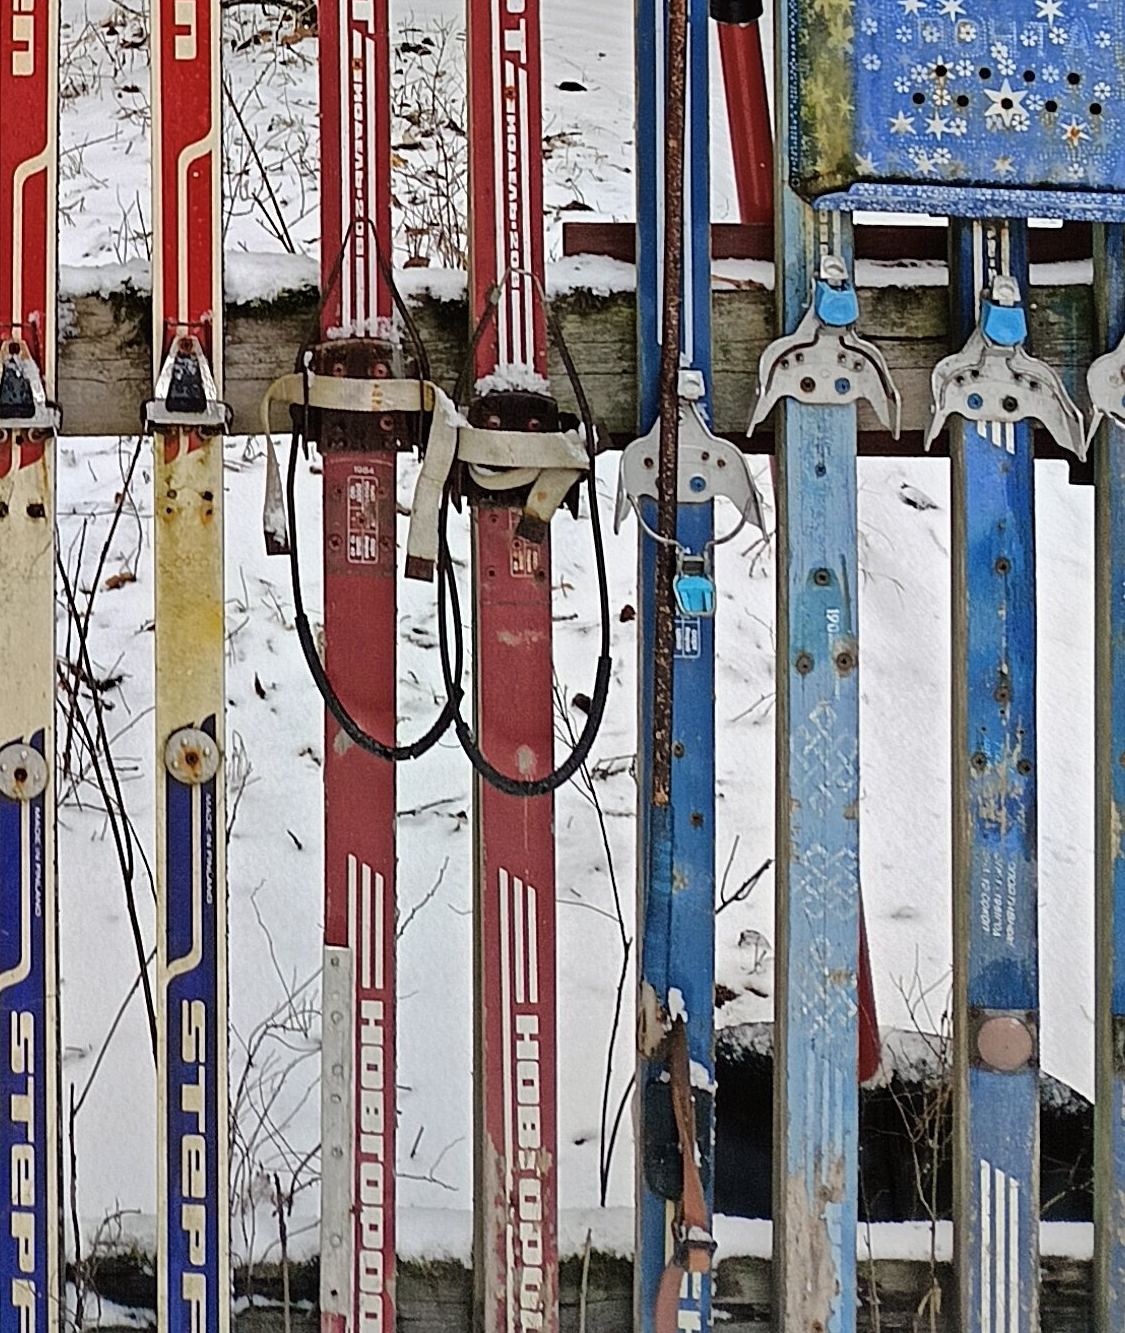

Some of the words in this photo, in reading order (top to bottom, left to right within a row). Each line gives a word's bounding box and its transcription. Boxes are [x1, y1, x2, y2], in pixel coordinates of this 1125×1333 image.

[826, 608, 840, 633] 190
[34, 806, 42, 844] MADE
[205, 793, 213, 831] MADE
[34, 863, 42, 918] FINLAND
[205, 849, 213, 905] FINLAND
